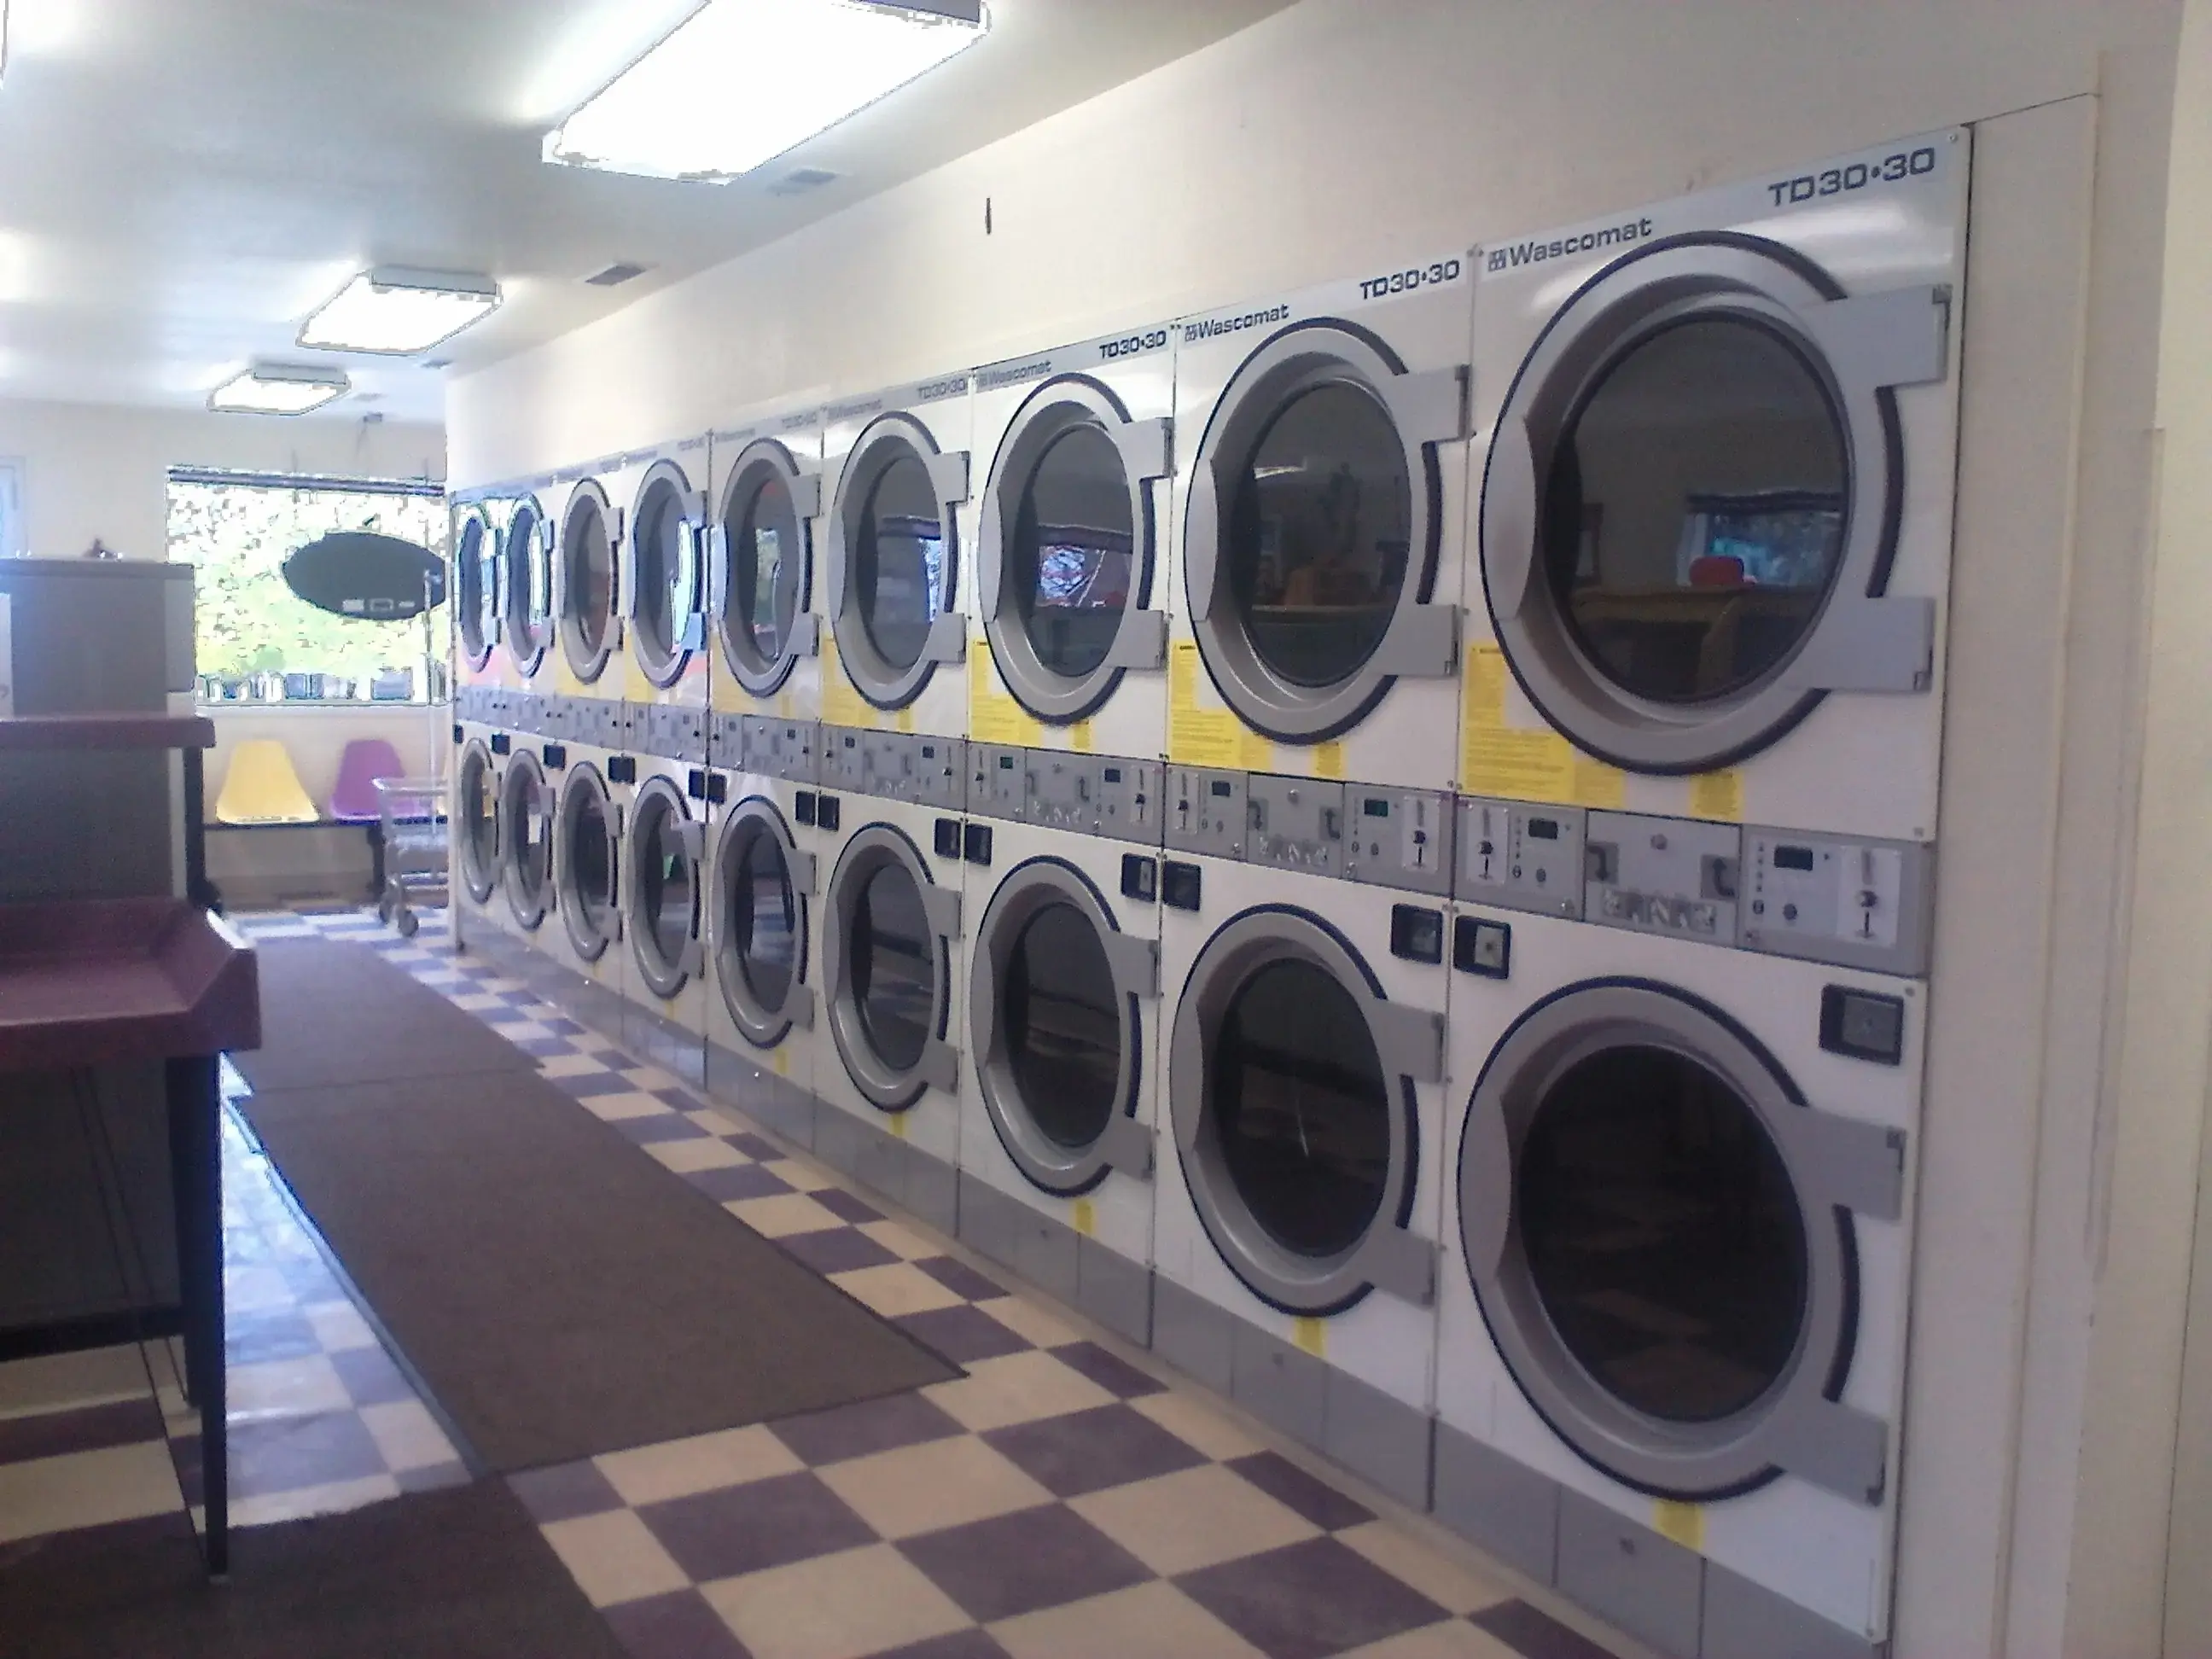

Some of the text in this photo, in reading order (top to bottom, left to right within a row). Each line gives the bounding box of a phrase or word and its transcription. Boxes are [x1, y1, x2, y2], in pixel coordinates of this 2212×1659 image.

[1508, 218, 1652, 267] Wascomat
[1198, 304, 1289, 341] Wascomat
[989, 359, 1052, 384] Wascomat
